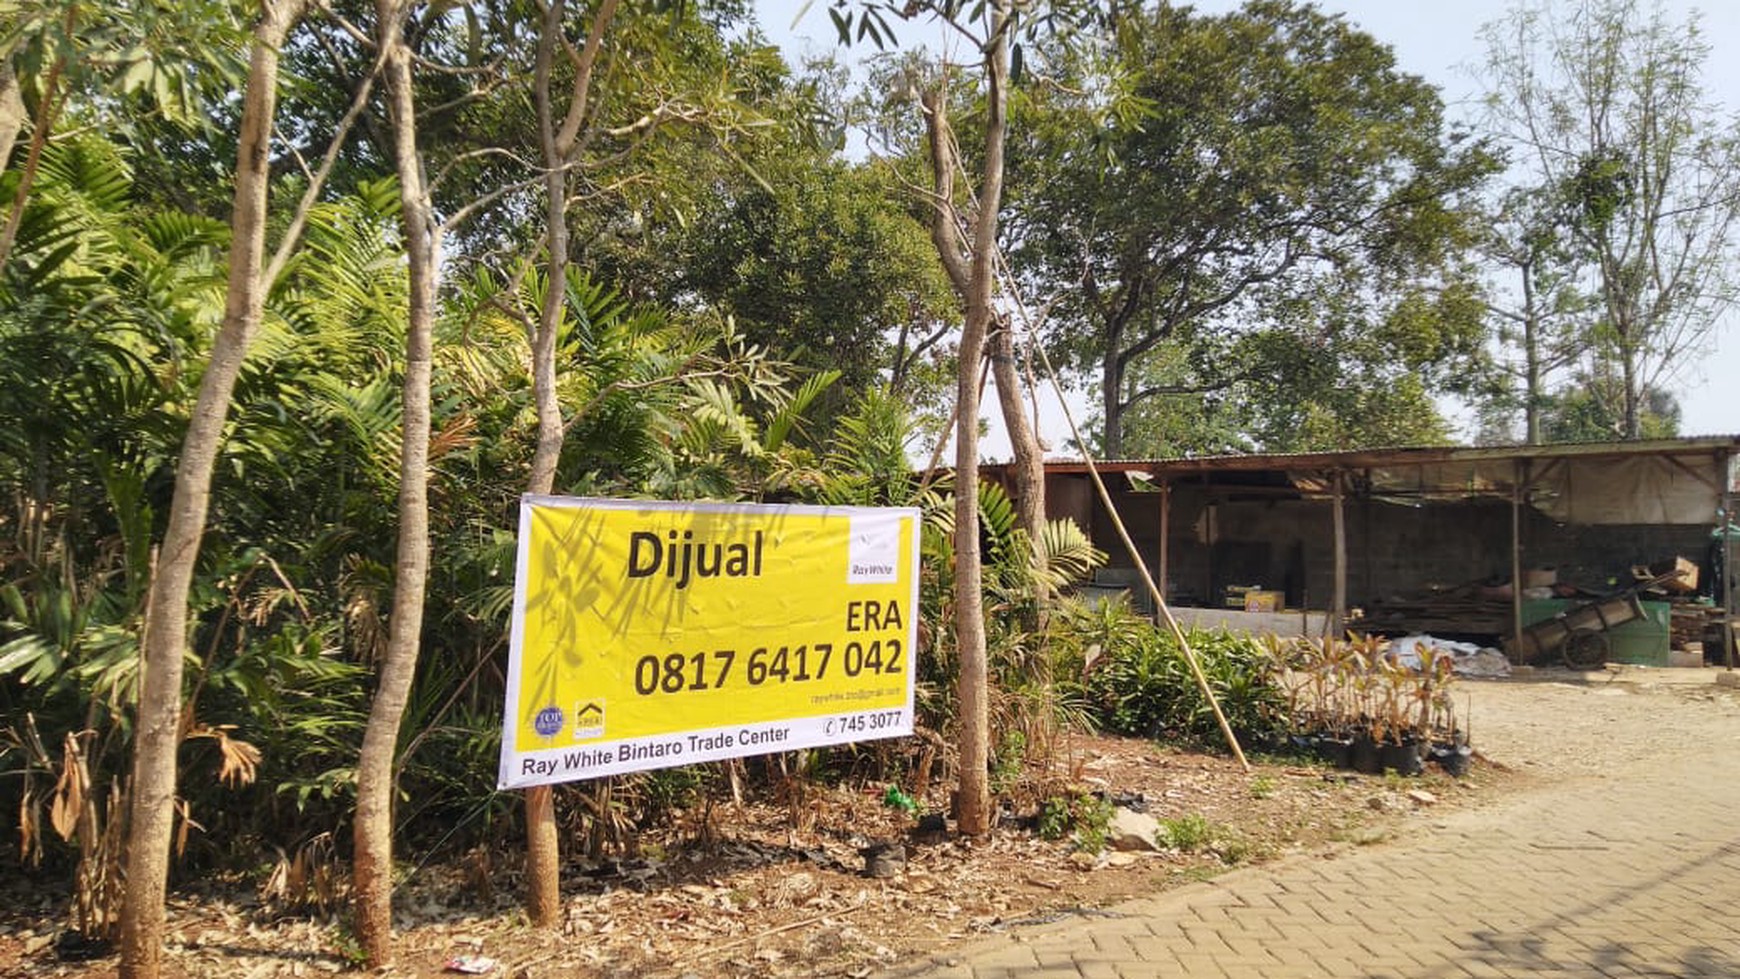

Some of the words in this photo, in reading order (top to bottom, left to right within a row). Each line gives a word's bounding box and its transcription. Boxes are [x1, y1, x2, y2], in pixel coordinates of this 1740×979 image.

[629, 530, 763, 588] Dijual
[846, 600, 902, 632] ERA
[635, 651, 735, 695] 0817
[746, 644, 833, 685] 6417
[843, 639, 902, 677] 042
[840, 715, 866, 734] 745
[869, 711, 902, 730] 3077
[522, 758, 558, 776] Ray
[564, 750, 613, 771] White
[618, 742, 683, 763] Bintaro
[687, 735, 734, 753] Trade
[738, 726, 790, 746] Center
